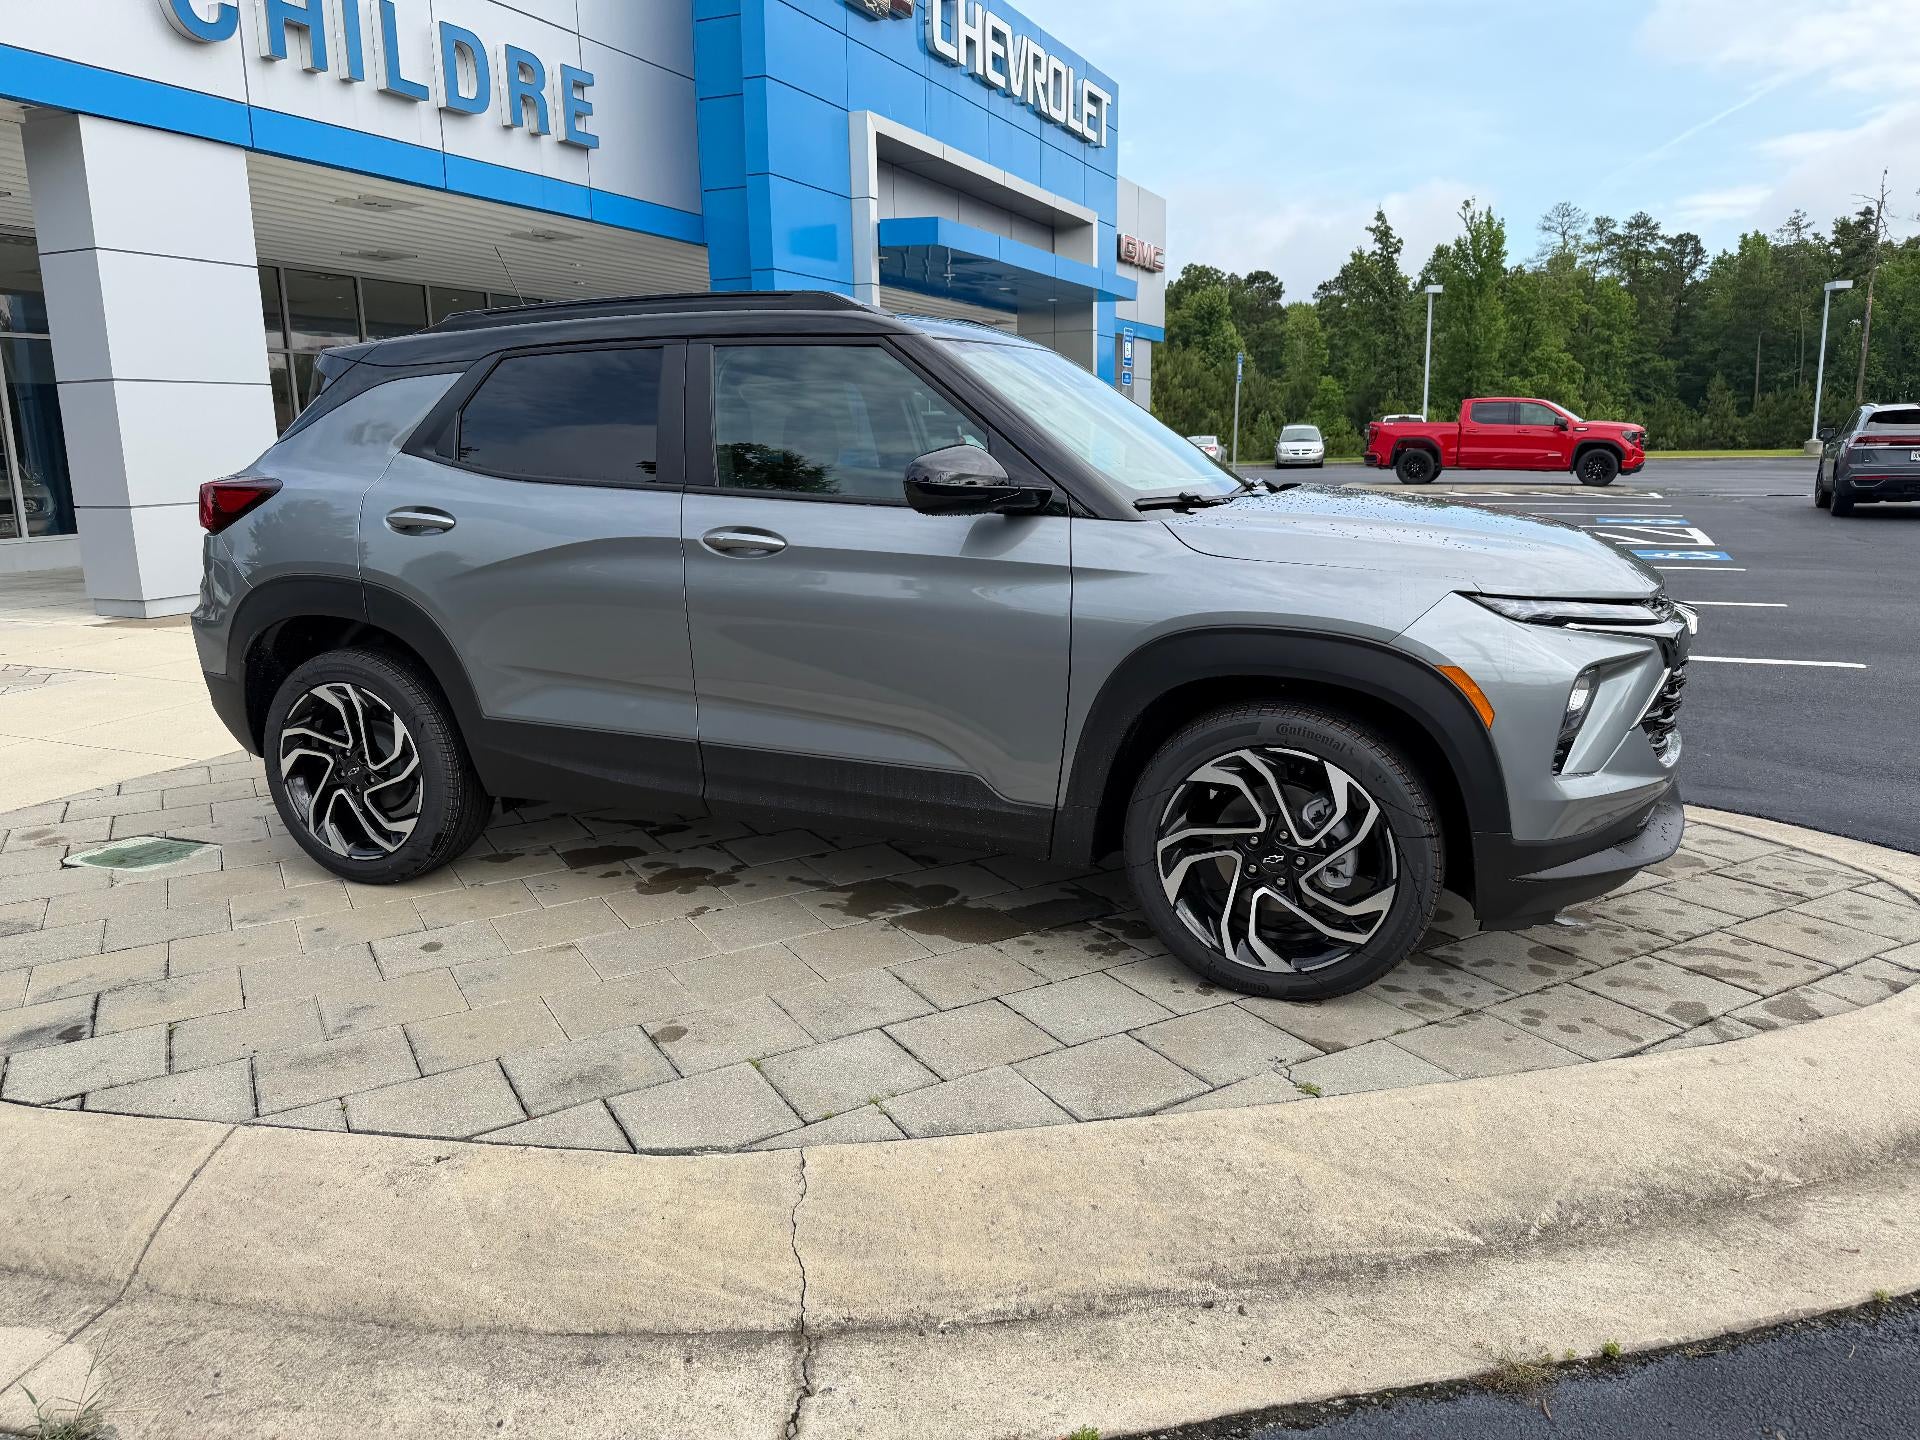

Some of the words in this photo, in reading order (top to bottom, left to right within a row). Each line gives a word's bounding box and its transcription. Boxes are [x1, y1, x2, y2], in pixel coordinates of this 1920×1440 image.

[925, 0, 1112, 147] CHEVROLET
[1120, 234, 1164, 272] GMC
[1275, 722, 1346, 753] Continental
